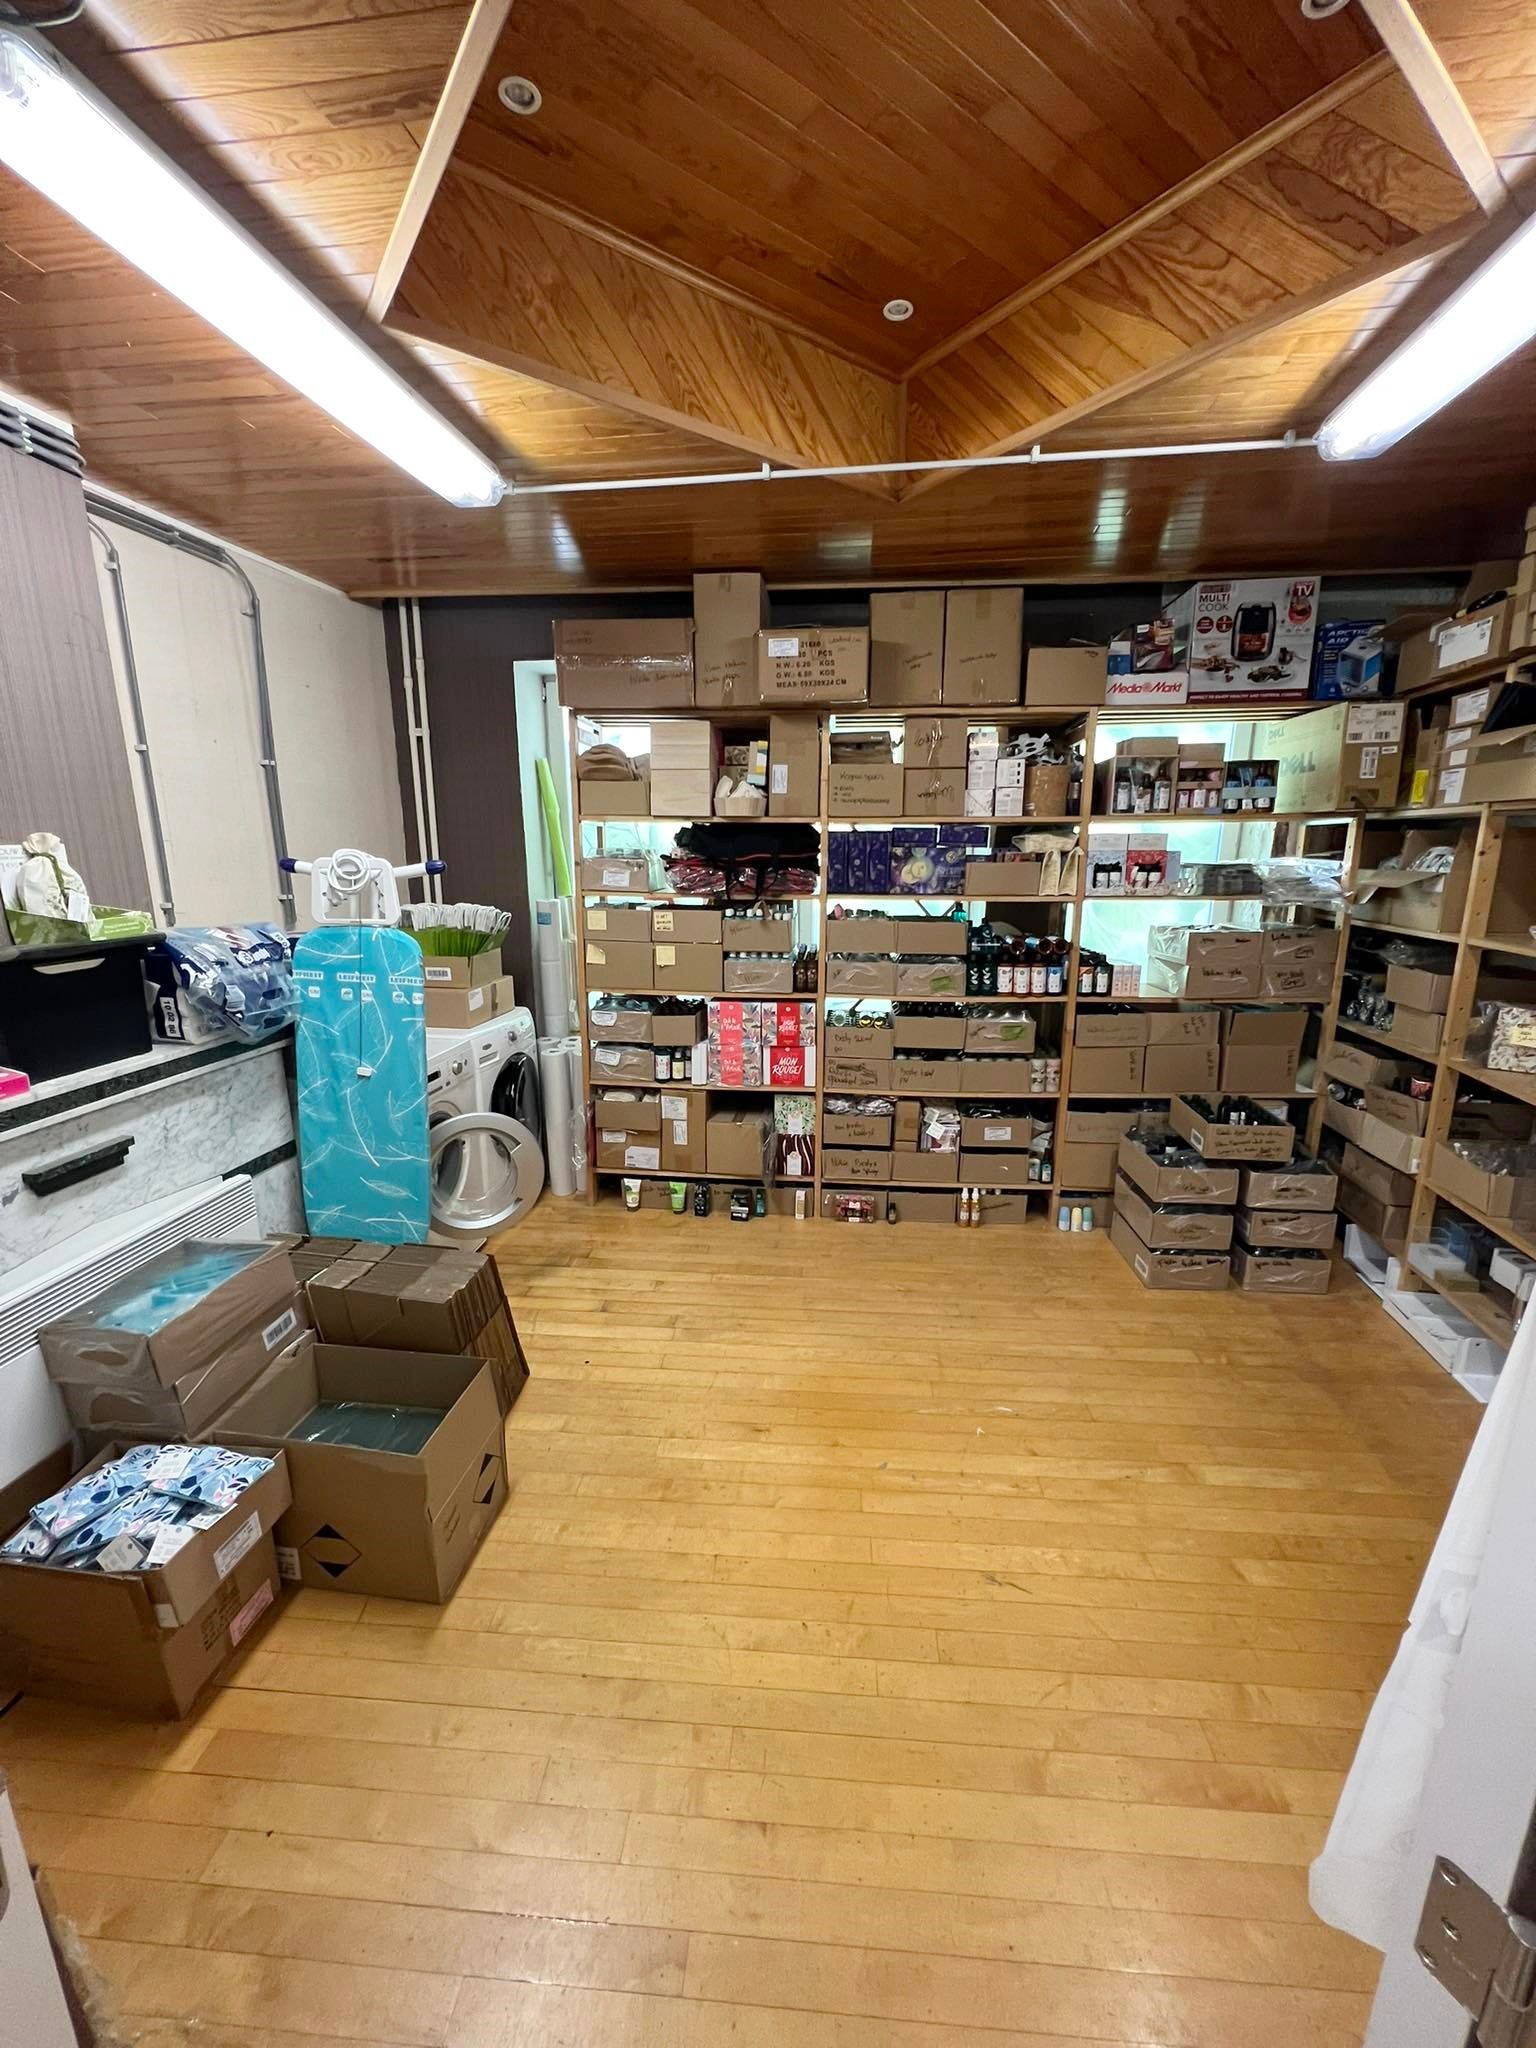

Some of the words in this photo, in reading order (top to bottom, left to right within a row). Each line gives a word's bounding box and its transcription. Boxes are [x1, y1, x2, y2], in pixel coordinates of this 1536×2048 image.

[1296, 585, 1313, 596] TV
[1200, 594, 1231, 603] MULTI
[1199, 603, 1229, 612] COOK
[819, 659, 835, 667] KGS
[819, 669, 835, 677] KGS
[1107, 681, 1143, 694] Media
[1149, 681, 1183, 694] Markt
[1279, 750, 1316, 777] DELL
[779, 1057, 799, 1066] MON
